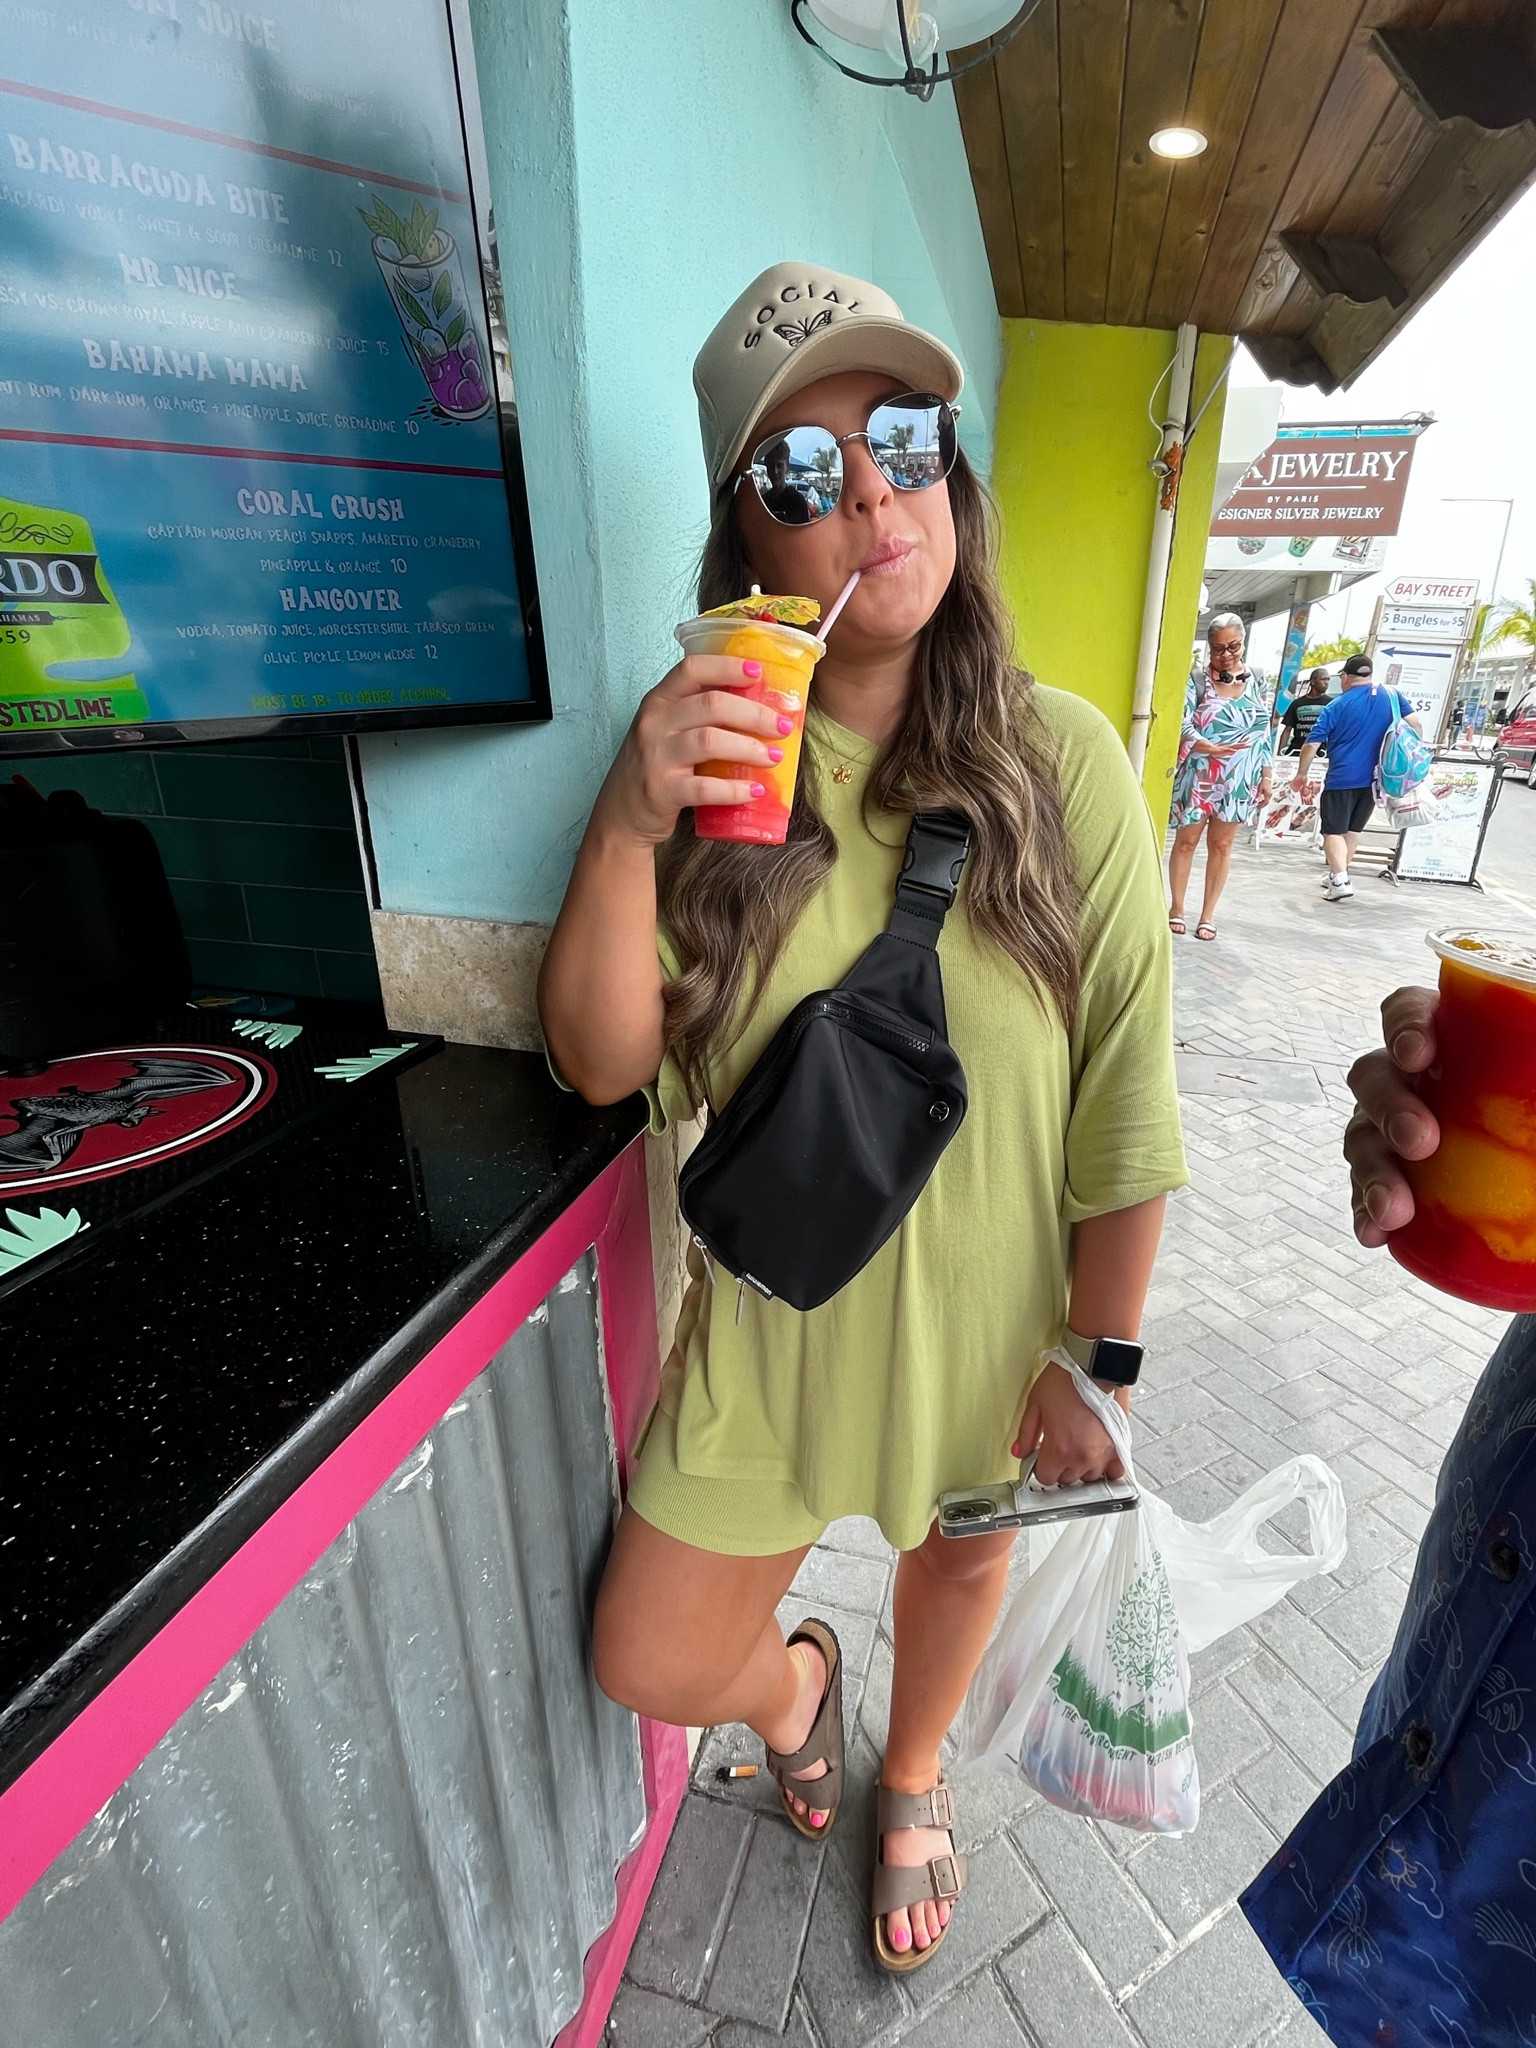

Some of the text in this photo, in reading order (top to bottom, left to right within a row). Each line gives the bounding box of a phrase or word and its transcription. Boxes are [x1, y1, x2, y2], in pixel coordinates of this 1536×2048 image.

[198, 0, 280, 53] JUICE
[7, 133, 290, 225] BARRACUDA BITE
[327, 249, 343, 269] 12
[118, 253, 241, 301] MR NICE
[743, 284, 861, 349] SOCIAL
[180, 310, 223, 332] APPLE
[228, 320, 255, 338] AND
[336, 338, 368, 354] JUICE
[375, 341, 390, 356] 15
[82, 338, 308, 393] BAHAMA MAMA
[69, 386, 112, 405] DARK
[153, 396, 208, 414] ORANGE
[211, 403, 221, 414] +
[225, 402, 292, 423] PINEAPPLE
[335, 414, 397, 434] GRENADINE
[403, 419, 420, 436] 10
[1262, 451, 1408, 486] JEWELRY
[237, 488, 405, 521] CORAL CRUSH
[1267, 495, 1319, 503] BY PARIS
[1275, 508, 1320, 520] SILVER
[1322, 507, 1384, 520] JEWELRY
[147, 522, 206, 539] CAPTAIN
[210, 526, 266, 543] MORGAN,
[268, 528, 307, 544] PEACH
[260, 557, 408, 574] PINEAPPLE & ORANGE 10
[279, 586, 403, 612] HANGOVER
[1395, 583, 1474, 598] BAY STREET
[176, 622, 225, 638] VODKA,
[227, 622, 277, 637] TOMATO
[465, 621, 495, 633] GREEN
[1392, 613, 1438, 627] Bangles
[1439, 618, 1450, 626] for
[1452, 616, 1465, 627] $5
[347, 649, 381, 662] LEMON
[384, 648, 416, 661] WEDGE
[424, 644, 438, 660] 12
[291, 694, 308, 708] BE
[313, 693, 332, 707] 18+
[337, 691, 353, 705] TO
[357, 690, 394, 704] ORDER
[1411, 691, 1441, 699] BANGLES
[1416, 699, 1432, 712] $5
[745, 1272, 772, 1296] lululemon
[1061, 1705, 1080, 1724] THE
